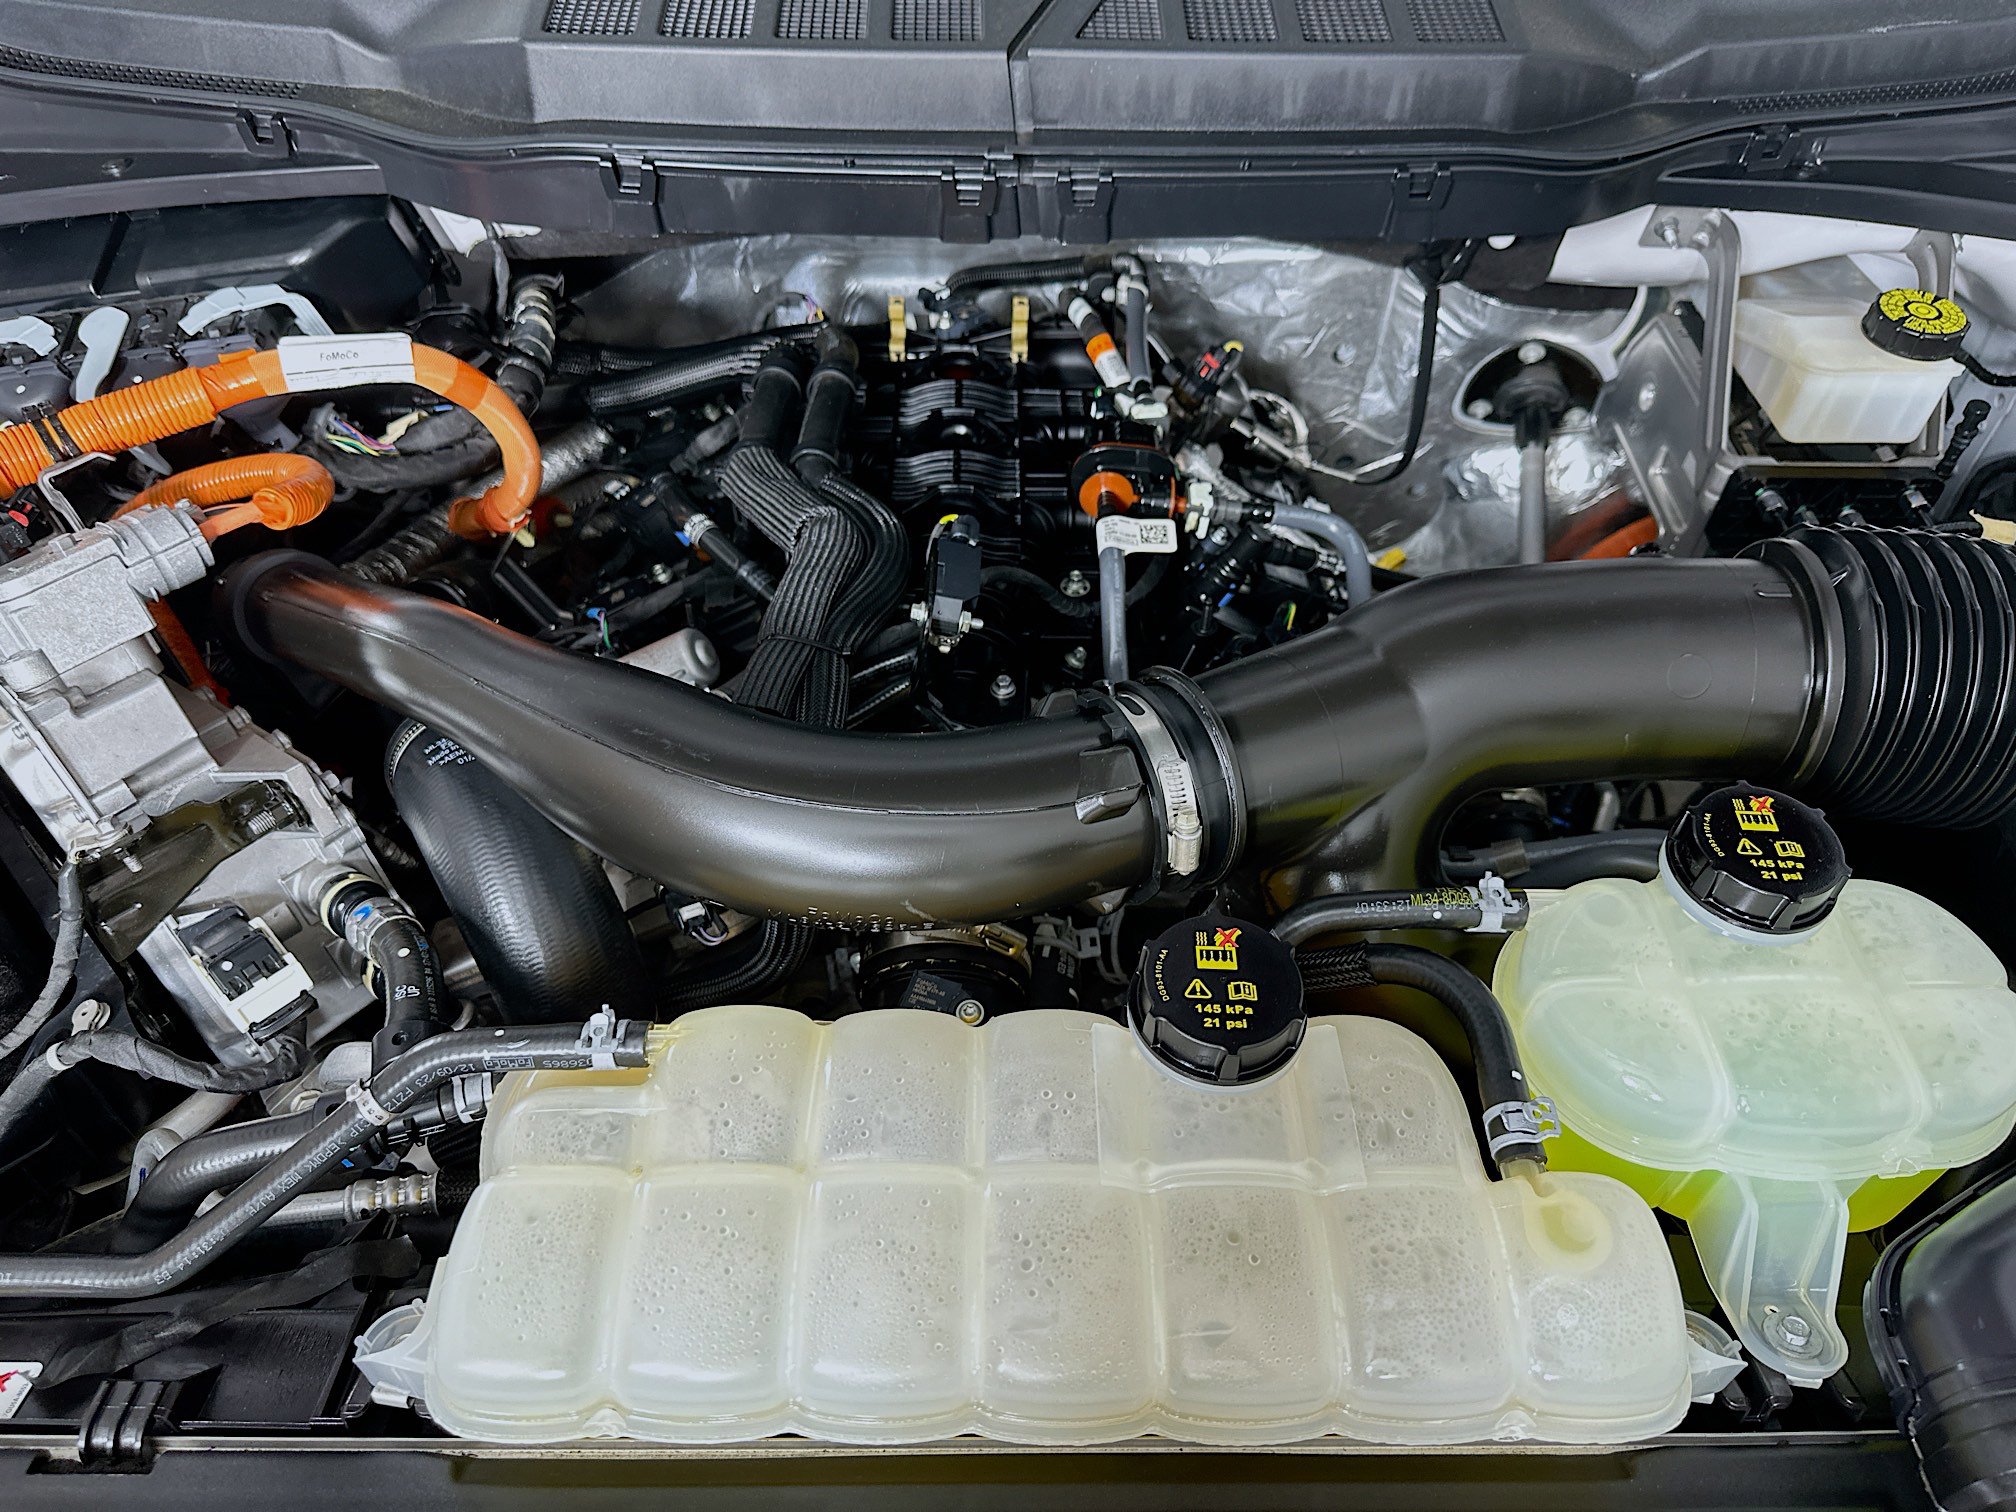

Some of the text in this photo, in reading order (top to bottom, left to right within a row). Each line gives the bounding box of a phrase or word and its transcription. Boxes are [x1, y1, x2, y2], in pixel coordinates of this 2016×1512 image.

[319, 349, 359, 361] FoMoCo
[427, 749, 450, 766] Made
[1703, 812, 1726, 858] DG93-8101-AA
[1750, 858, 1805, 869] 145 kPa
[1760, 870, 1803, 882] 21 psi
[1354, 899, 1411, 915] 12:33:07
[1155, 949, 1170, 1002] DG93-8101-AA
[407, 985, 421, 998] UP
[1195, 1004, 1254, 1015] 145 kPa
[1203, 1018, 1248, 1030] 21 psi
[483, 1056, 534, 1070] FoMoCo
[415, 1062, 477, 1087] 12/09/23
[277, 1171, 303, 1193] MEX
